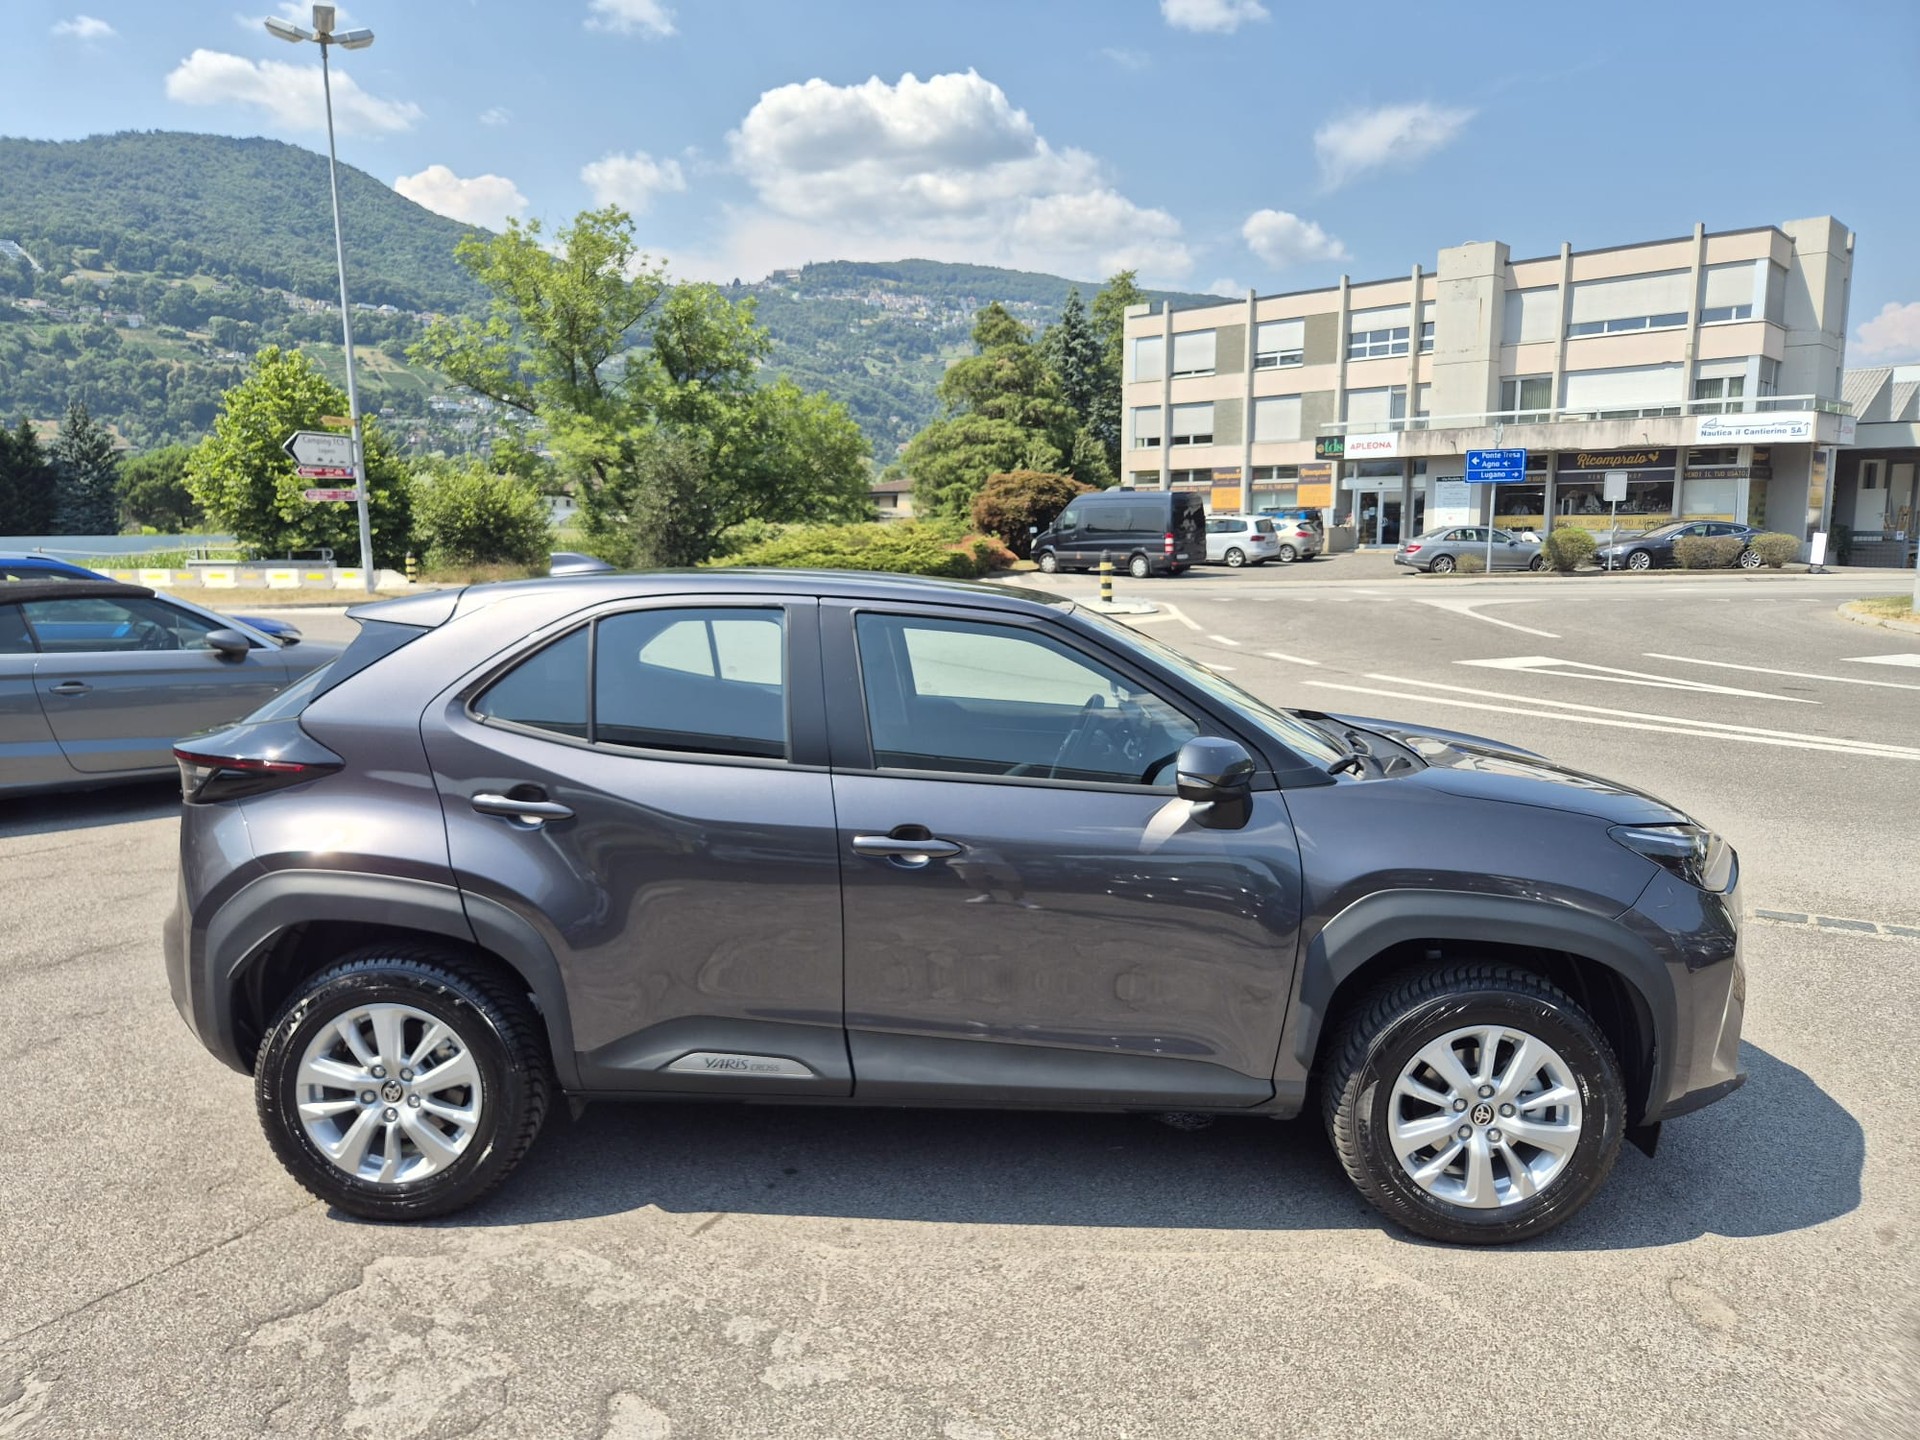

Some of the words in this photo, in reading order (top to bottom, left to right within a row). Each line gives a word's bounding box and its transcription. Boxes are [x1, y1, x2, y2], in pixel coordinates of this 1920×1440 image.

[303, 436, 331, 446] Camping
[1350, 441, 1392, 450] APLEONA
[1481, 461, 1500, 469] Agno
[1577, 452, 1648, 468] Ricompralo
[705, 1058, 749, 1070] YARIS
